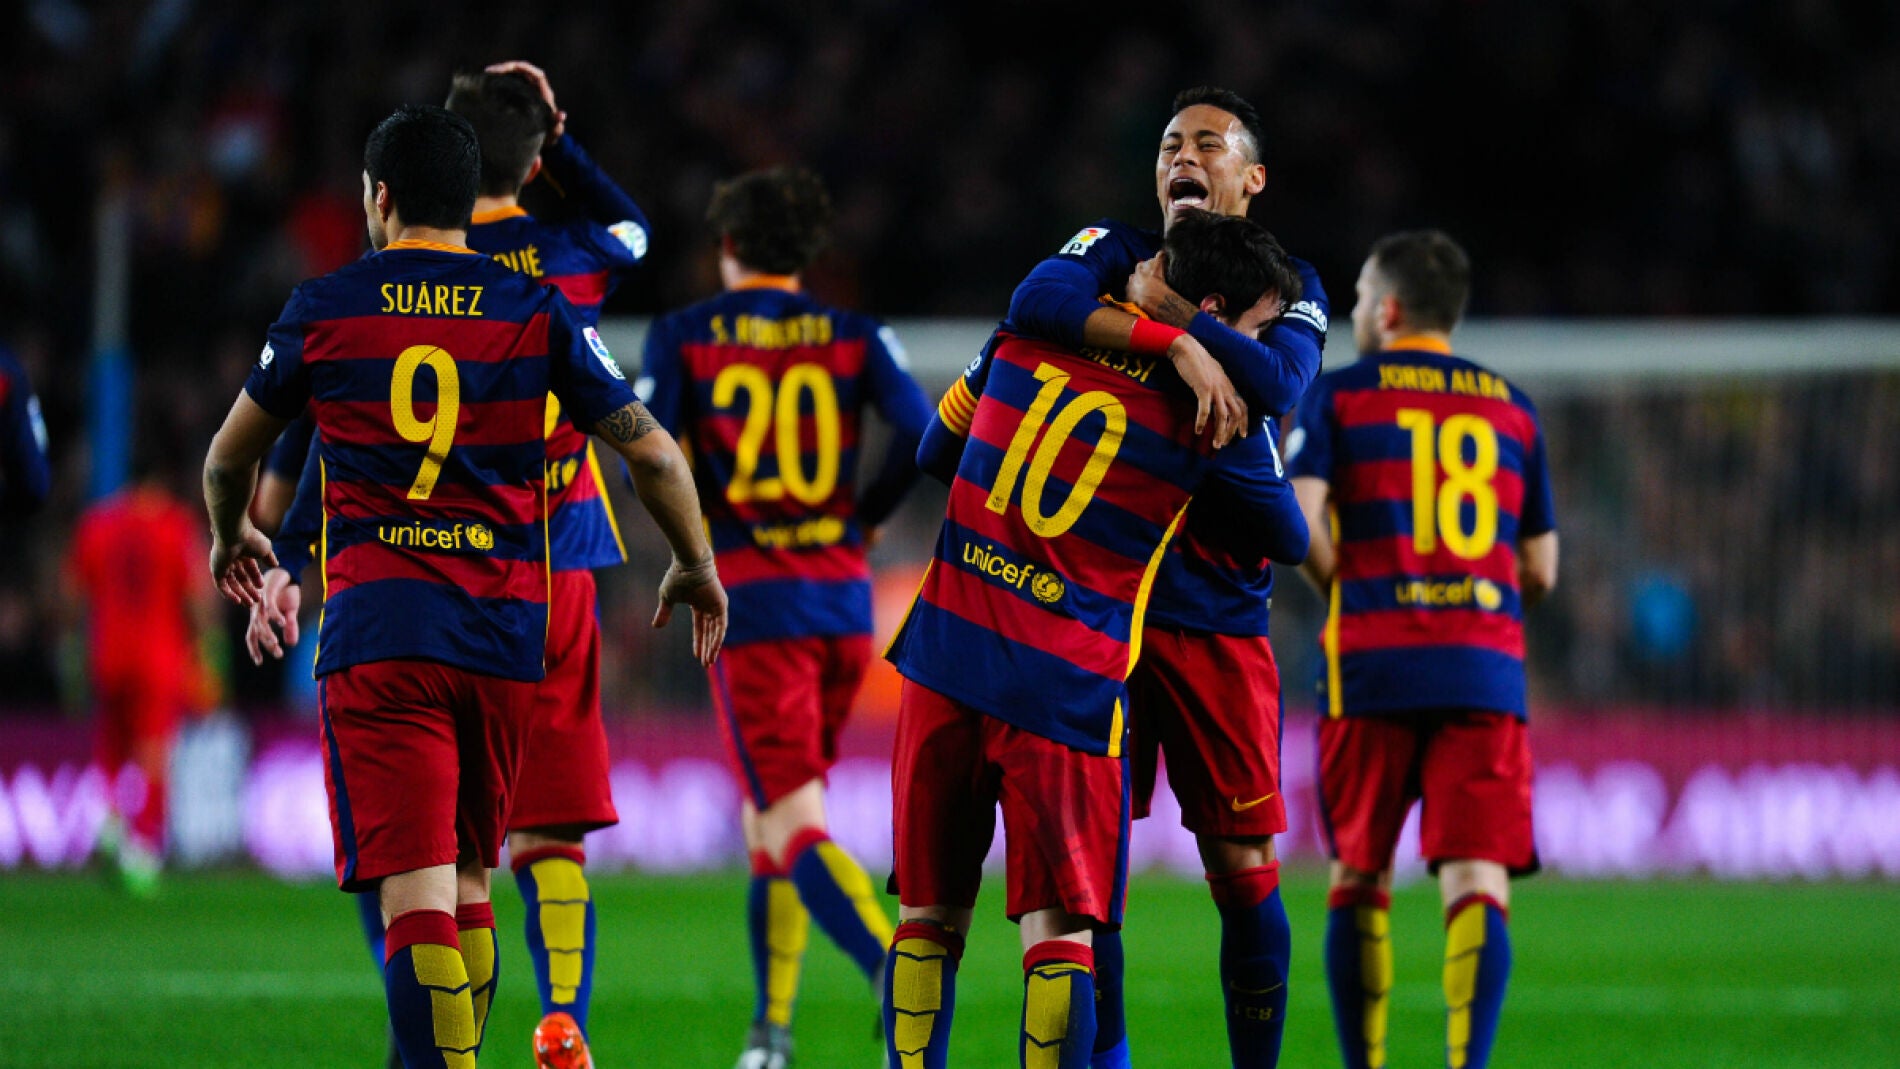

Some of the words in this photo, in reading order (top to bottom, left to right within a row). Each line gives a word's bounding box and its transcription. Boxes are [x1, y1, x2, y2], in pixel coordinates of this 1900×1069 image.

[381, 281, 484, 316] SUÁREZ
[1290, 300, 1328, 332] eko
[1379, 364, 1445, 392] JORDI
[1451, 368, 1511, 402] ALBA
[390, 344, 460, 500] 9
[711, 362, 841, 506] 20
[984, 361, 1127, 538] 10
[1396, 408, 1499, 560] 18
[379, 521, 463, 549] unicef
[963, 542, 1034, 590] unicef
[1395, 574, 1473, 605] unicef
